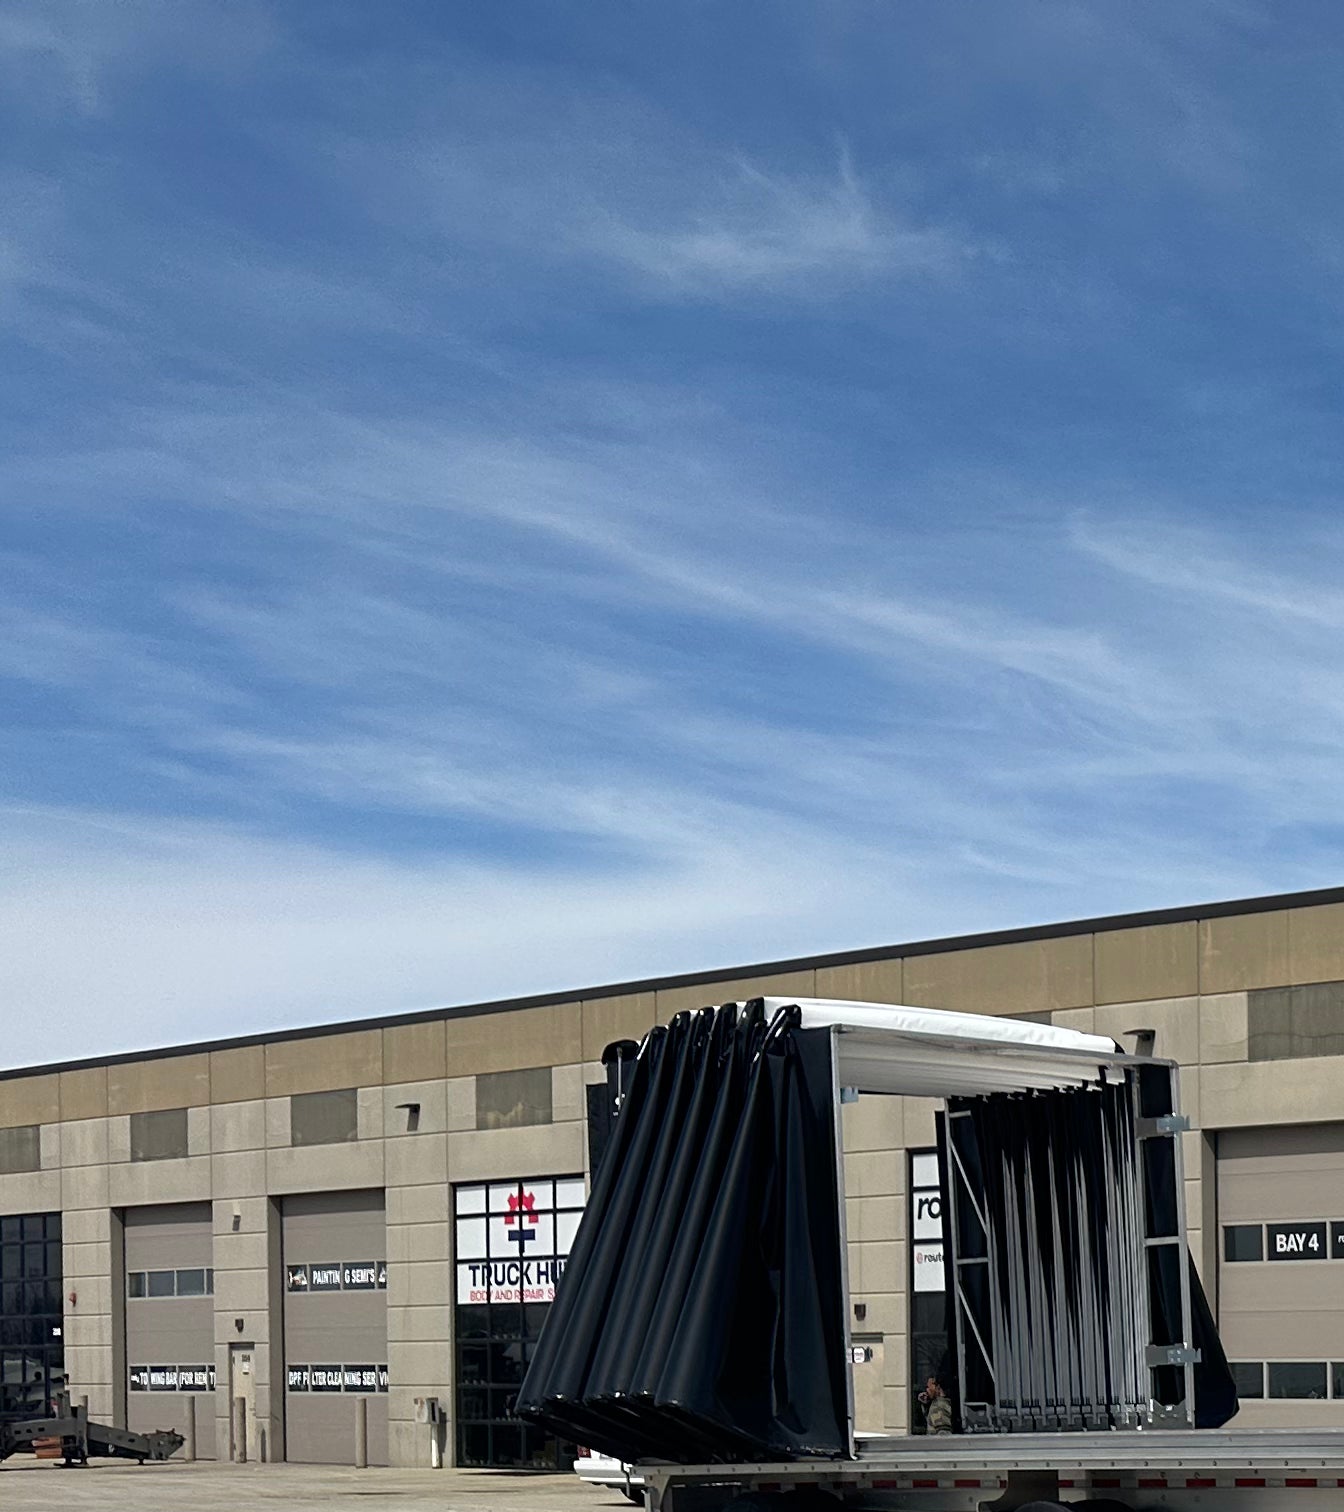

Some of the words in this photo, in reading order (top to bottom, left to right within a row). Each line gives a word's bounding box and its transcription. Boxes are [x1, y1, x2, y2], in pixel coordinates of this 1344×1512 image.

[1276, 1233, 1306, 1252] BAY
[1308, 1233, 1319, 1251] 4
[468, 1263, 532, 1286] TRUCK
[470, 1290, 492, 1301] BOD
[495, 1290, 513, 1300] AND
[515, 1289, 544, 1300] RPAIR
